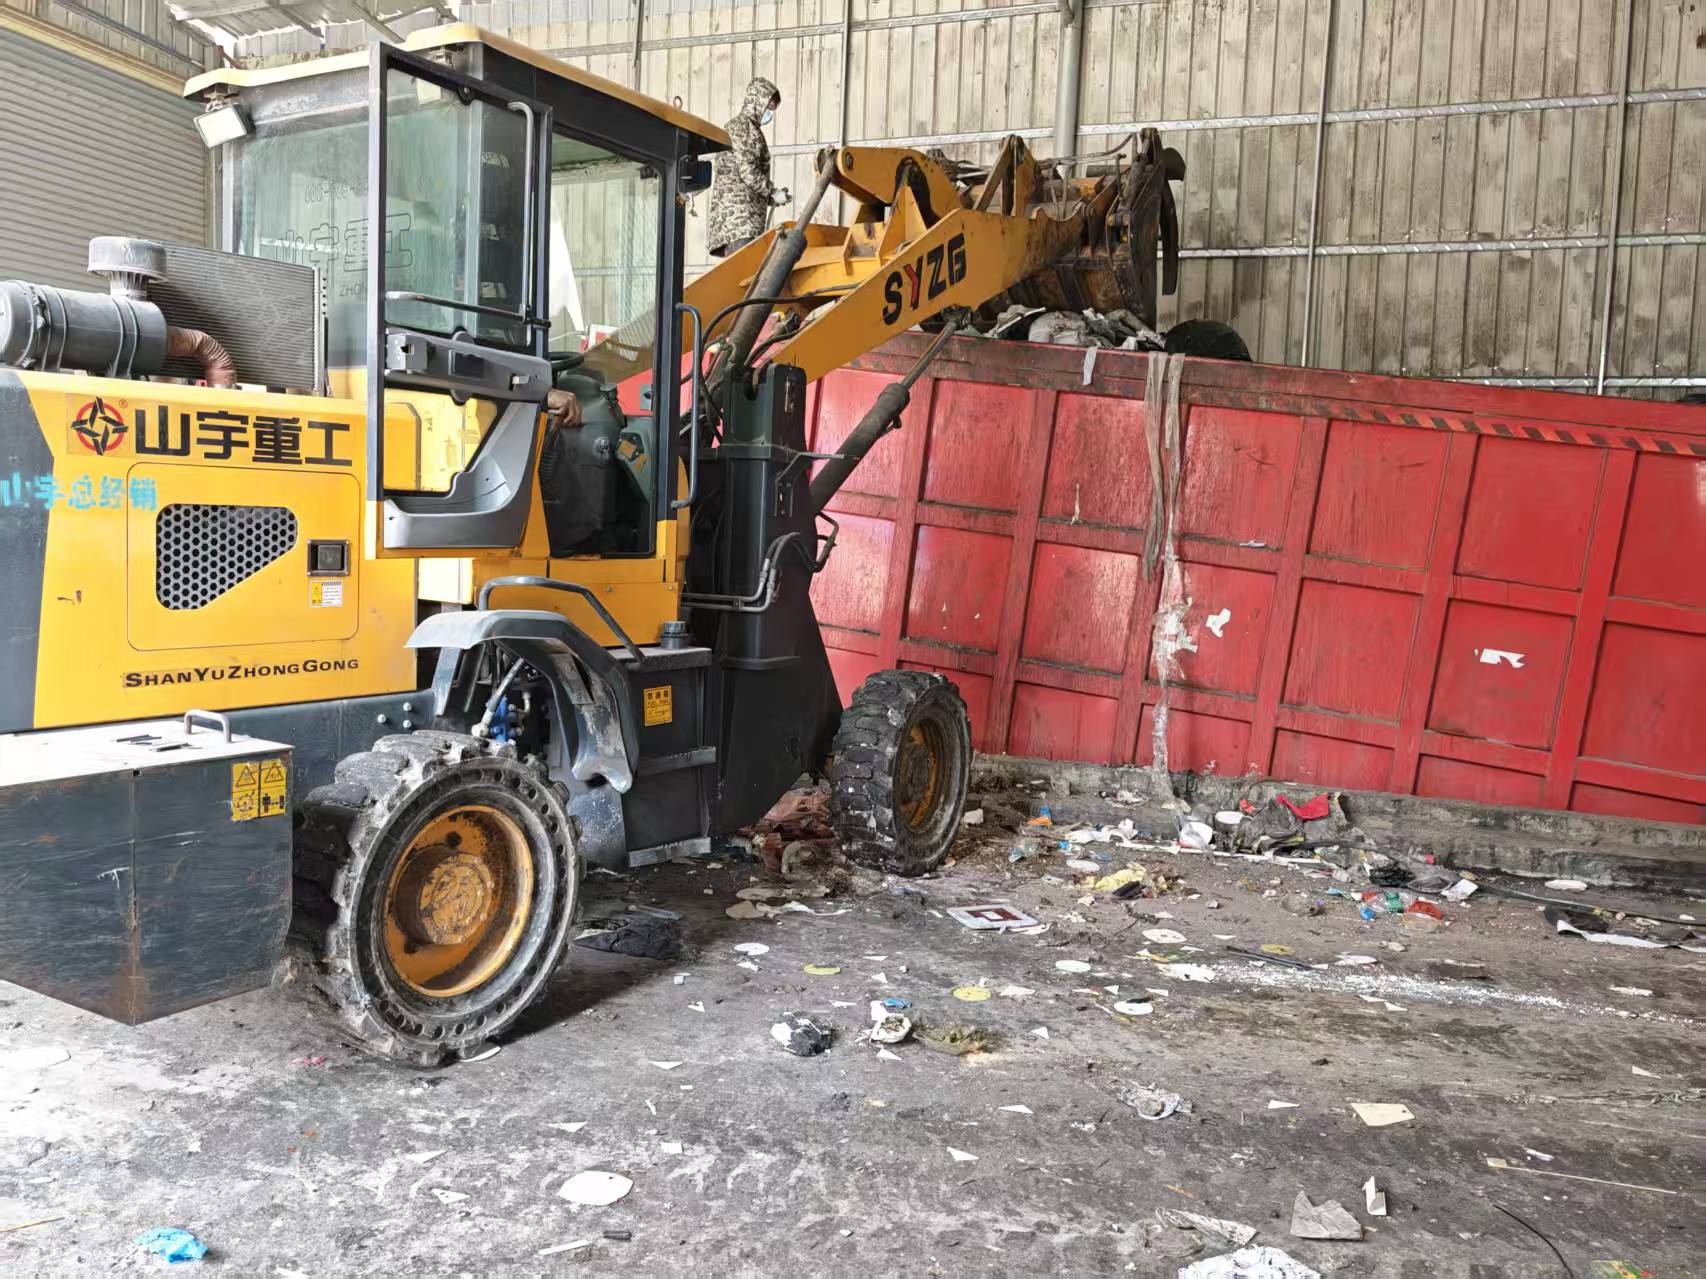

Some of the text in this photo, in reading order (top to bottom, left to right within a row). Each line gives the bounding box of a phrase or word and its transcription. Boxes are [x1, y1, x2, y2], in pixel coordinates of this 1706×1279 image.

[883, 233, 966, 326] SYZG
[135, 405, 352, 467] 山宇重工
